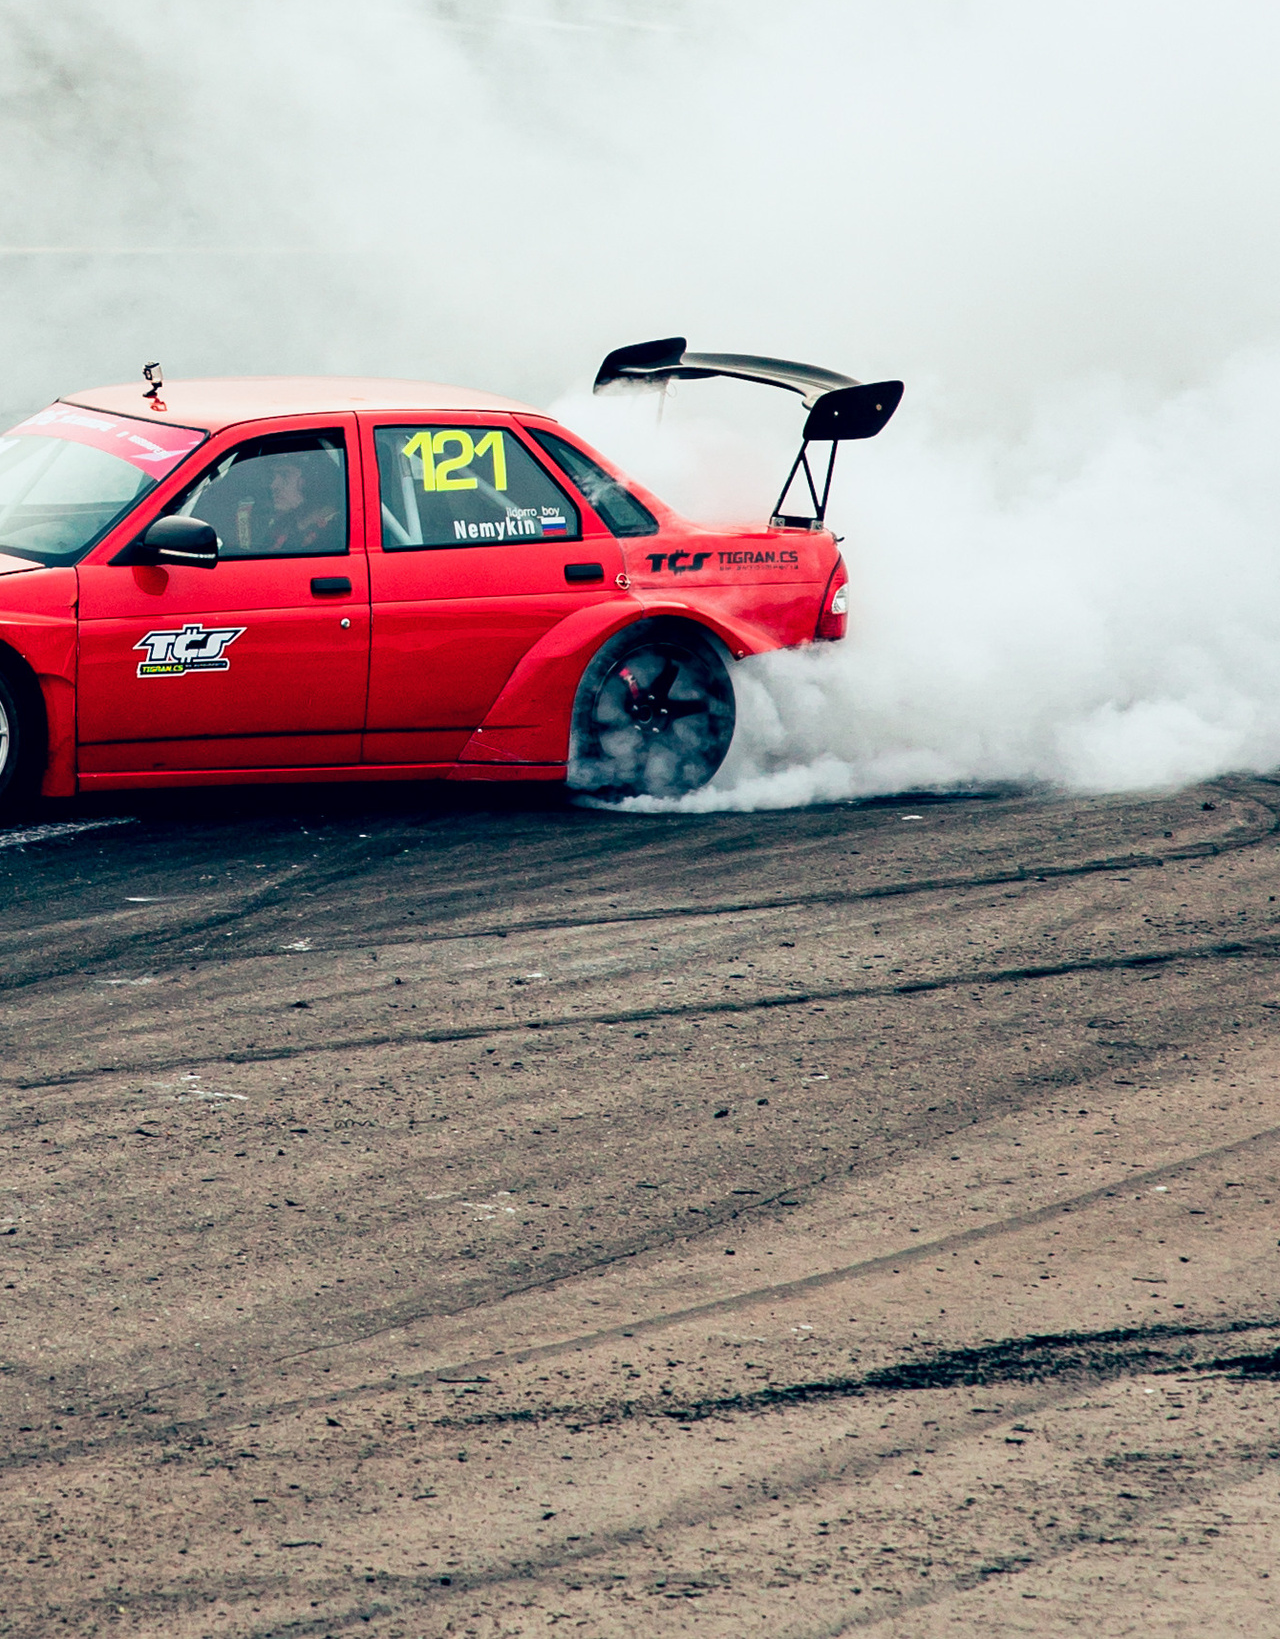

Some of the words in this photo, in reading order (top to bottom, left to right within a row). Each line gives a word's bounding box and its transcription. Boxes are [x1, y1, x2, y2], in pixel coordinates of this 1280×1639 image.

[402, 430, 507, 491] 121
[454, 517, 536, 540] Nemykin
[717, 550, 798, 564] TIGRAN.CS
[142, 664, 184, 673] TIGRAN.CS
